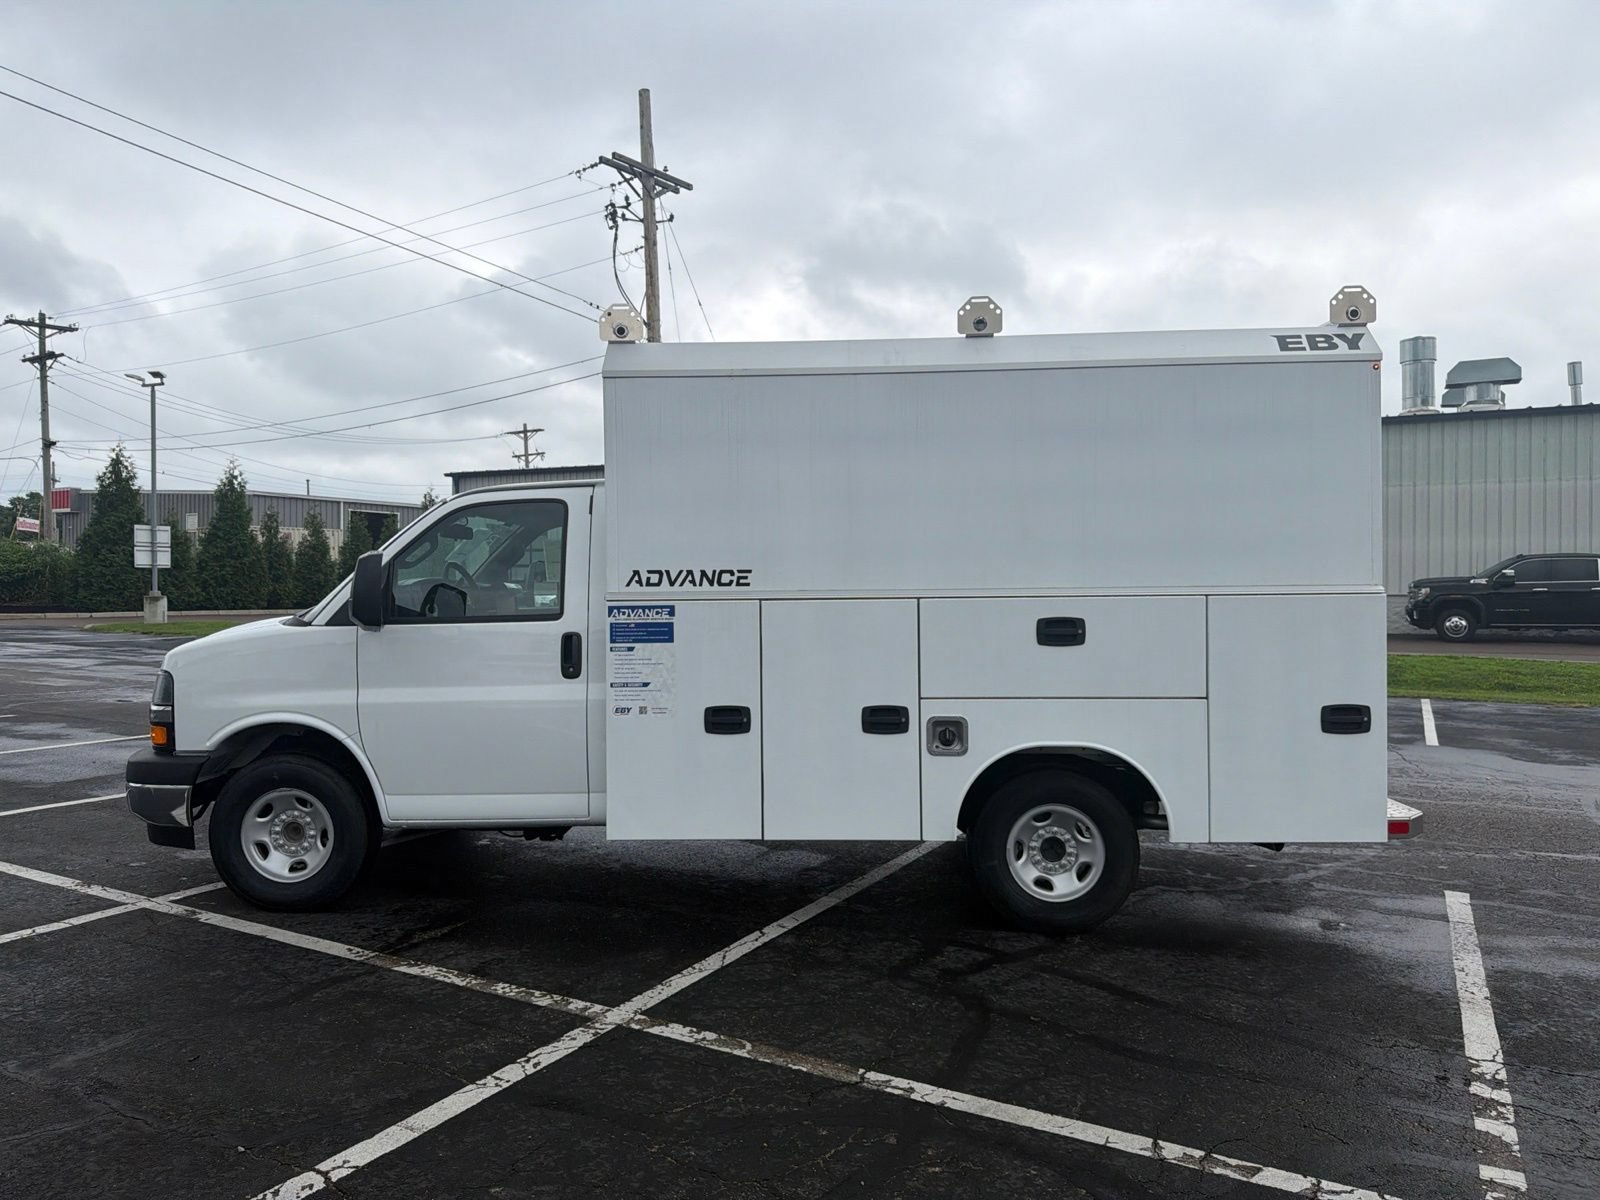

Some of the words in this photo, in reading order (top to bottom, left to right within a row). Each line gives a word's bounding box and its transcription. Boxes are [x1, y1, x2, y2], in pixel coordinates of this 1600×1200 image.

[1270, 333, 1365, 352] EBY
[625, 569, 752, 587] ADVANCE
[610, 608, 671, 618] ADVANCE
